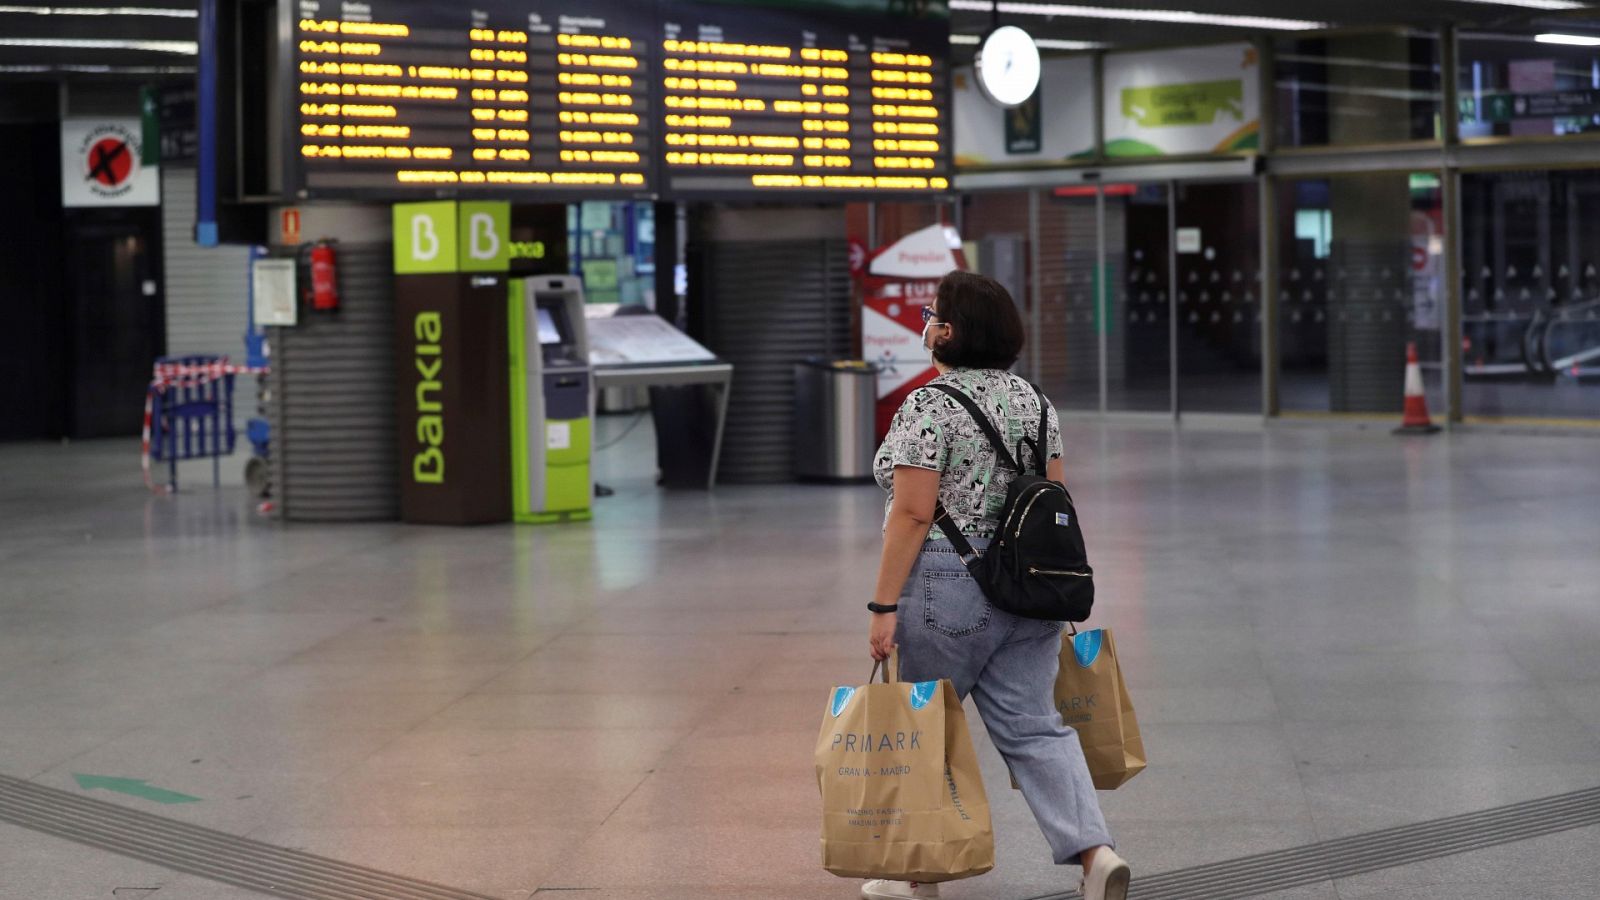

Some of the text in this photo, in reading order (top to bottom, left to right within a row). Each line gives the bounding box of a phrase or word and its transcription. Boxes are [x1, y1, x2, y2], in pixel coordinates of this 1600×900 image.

[411, 213, 439, 261] B
[469, 212, 499, 260] B
[413, 311, 445, 484] Bankia
[1059, 694, 1096, 712] ARK
[831, 730, 921, 752] PRIMARK
[838, 766, 861, 777] GRAN
